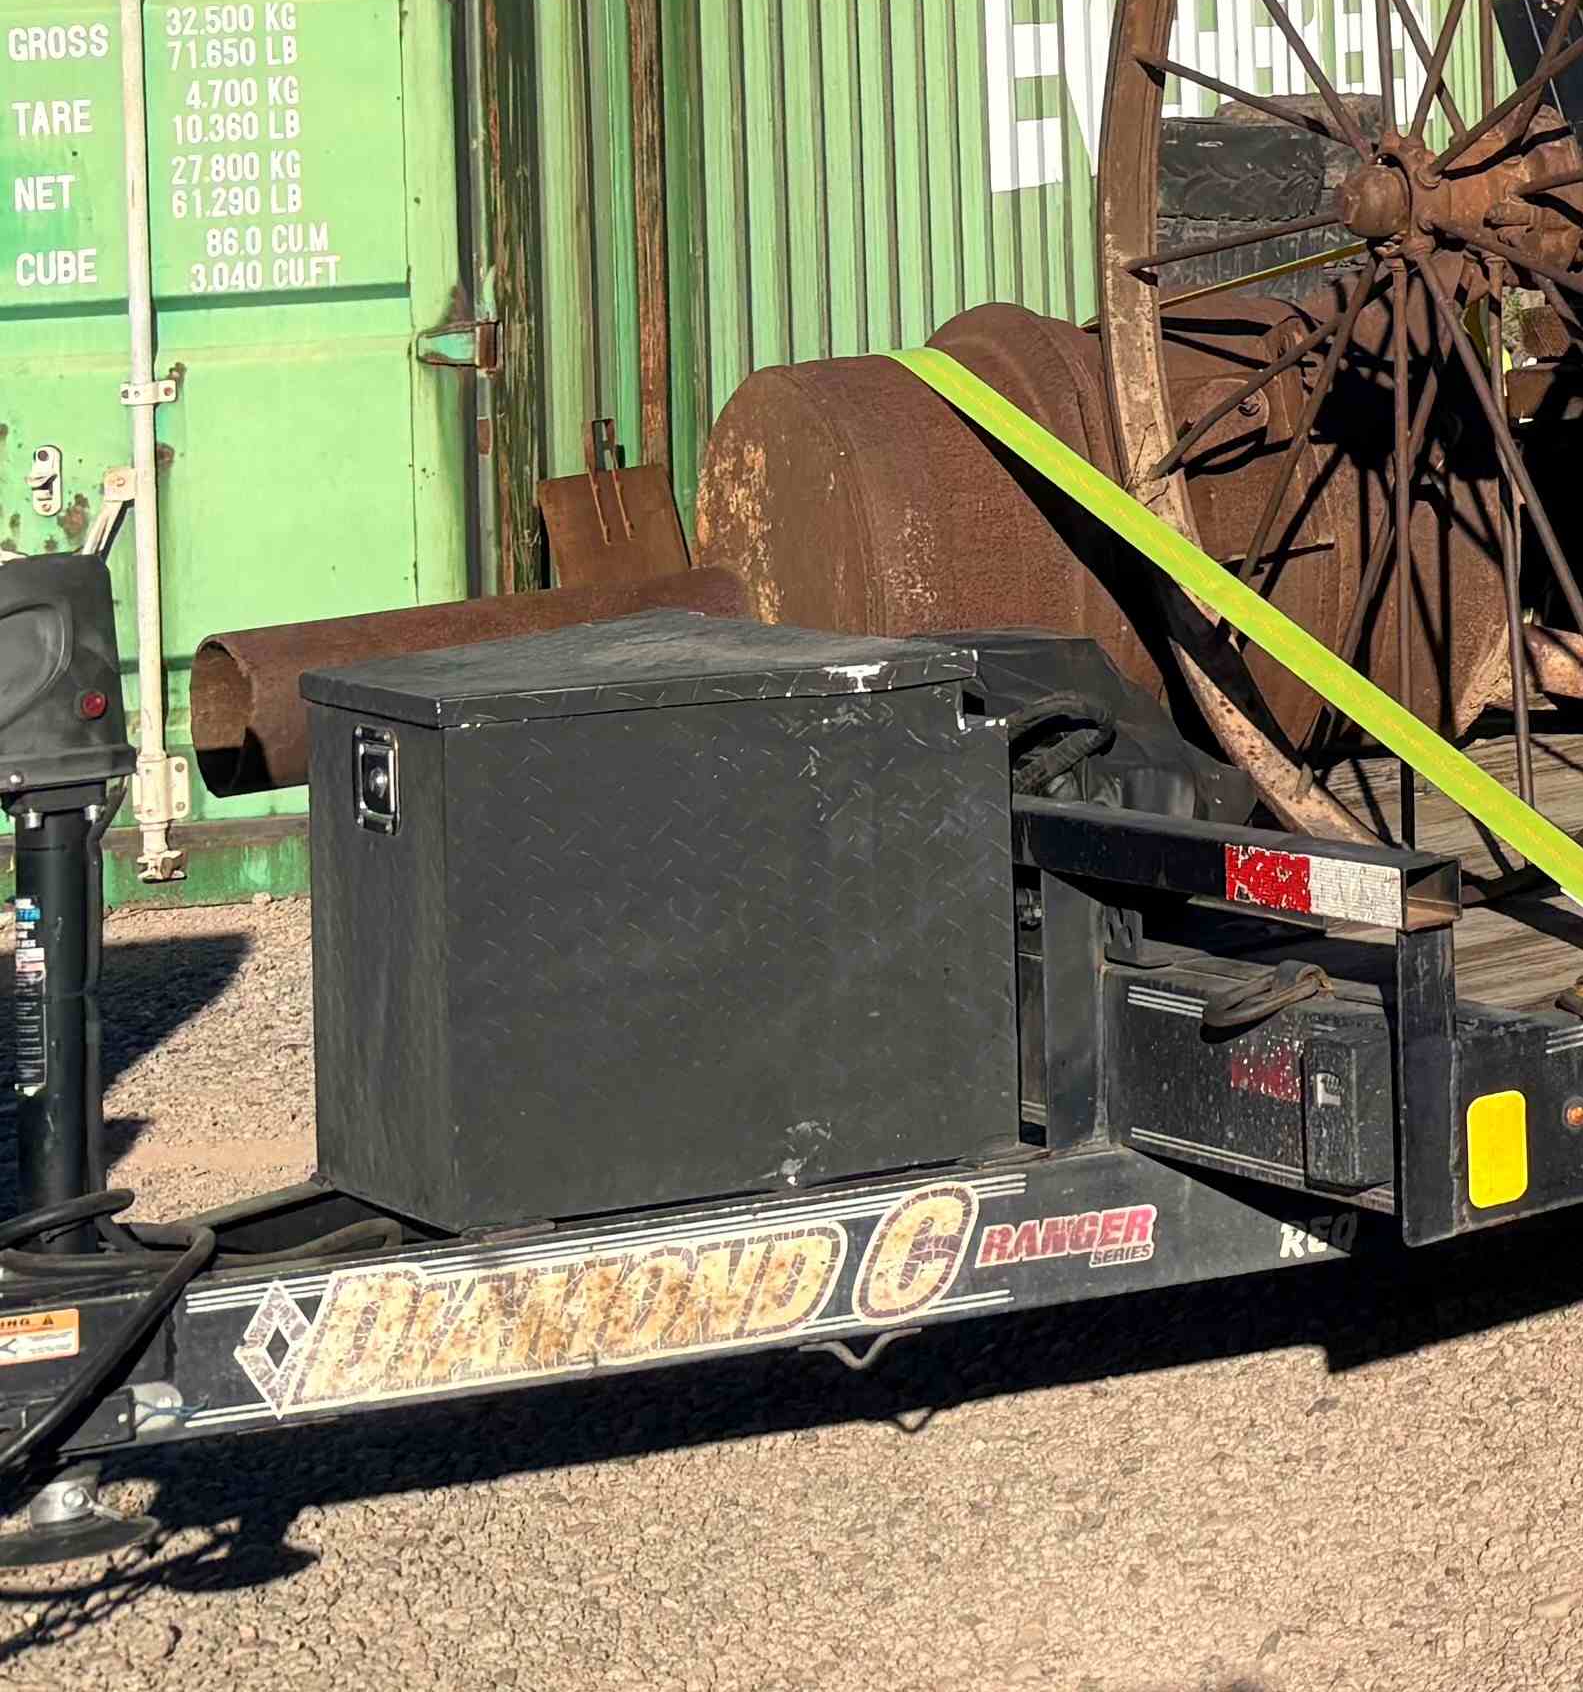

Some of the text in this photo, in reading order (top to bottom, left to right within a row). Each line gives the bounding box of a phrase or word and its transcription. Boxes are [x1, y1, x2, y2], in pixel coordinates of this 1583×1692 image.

[165, 3, 296, 36] 32.500 KG
[8, 23, 109, 61] GROSS
[167, 36, 298, 70] 71.650 LB
[185, 76, 299, 109] 4.700 KG
[12, 100, 92, 137] TARE
[172, 109, 301, 144] 10.360 LB
[170, 150, 302, 185] 27.800 KG
[14, 174, 76, 212] NET
[171, 185, 303, 219] 61.290 LB
[206, 223, 329, 257] 86.0 CU.M
[15, 248, 97, 287] CUBE
[191, 255, 341, 293] 3.040 CU.FT
[977, 1204, 1158, 1267] RANGER
[1092, 1243, 1152, 1267] SERIES
